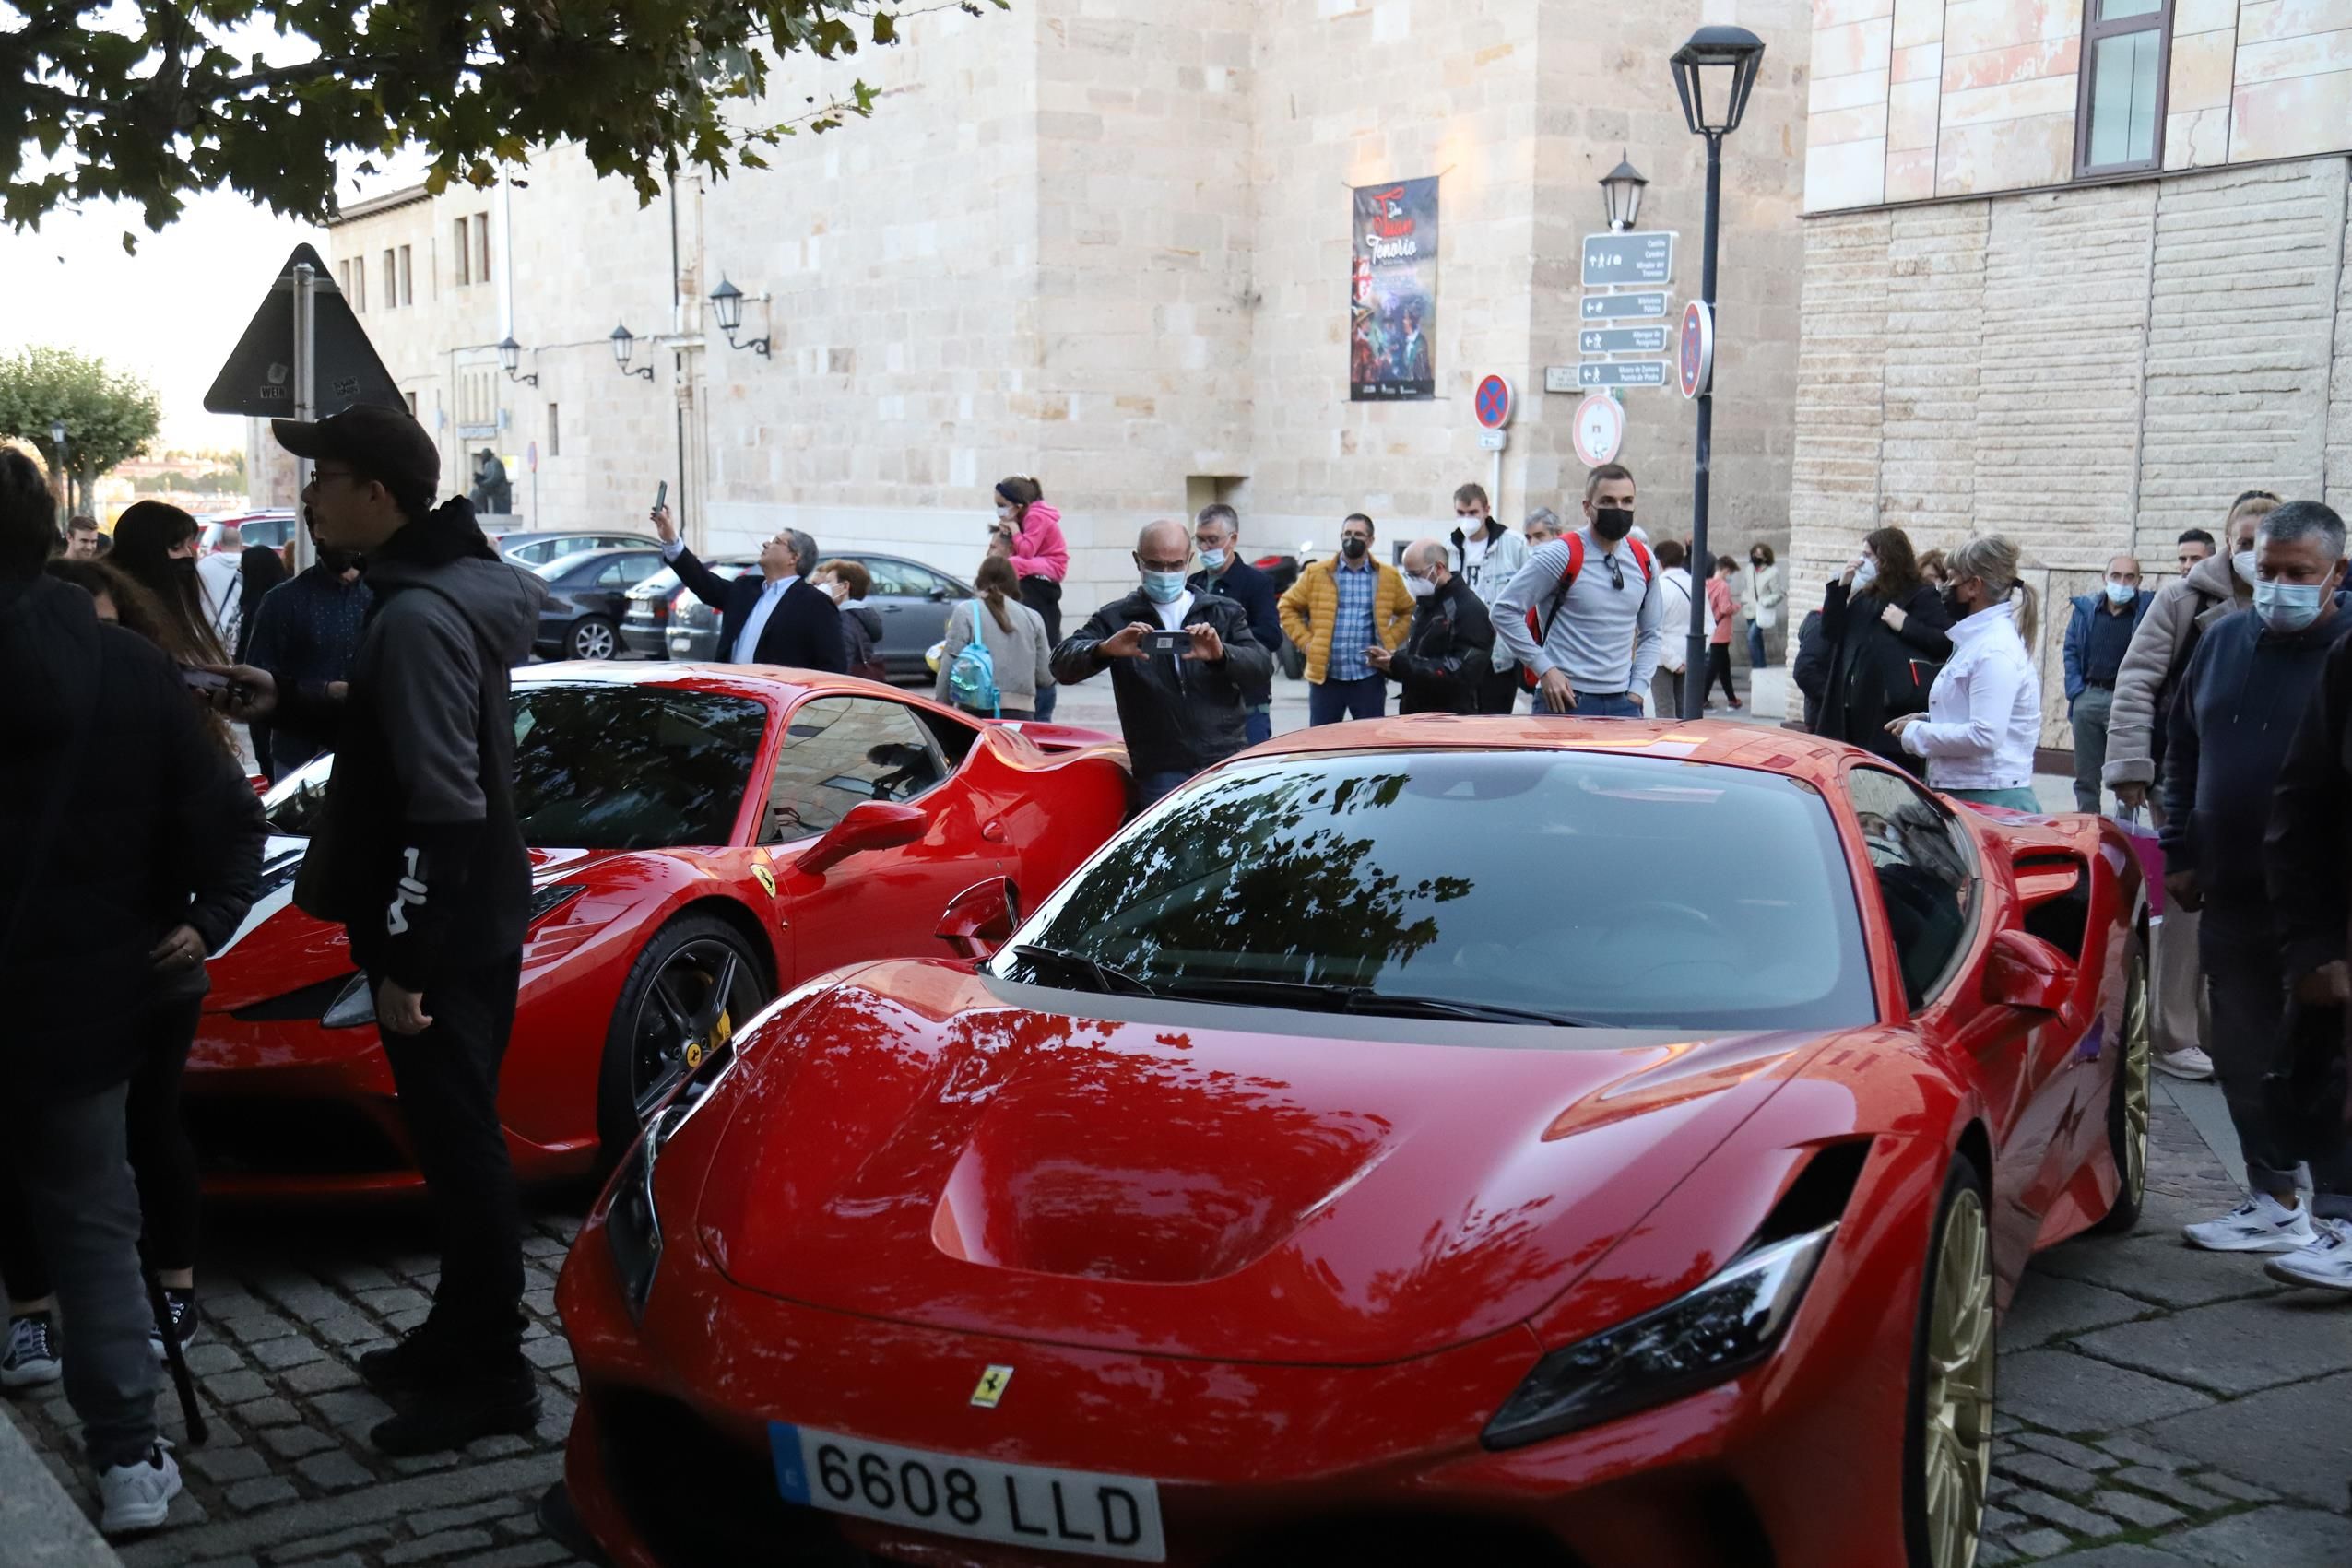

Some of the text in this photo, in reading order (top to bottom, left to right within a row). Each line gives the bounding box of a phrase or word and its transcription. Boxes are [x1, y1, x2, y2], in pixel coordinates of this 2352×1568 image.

[1365, 234, 1417, 265] Tenorio
[817, 1444, 1141, 1546] 6608 LLD
